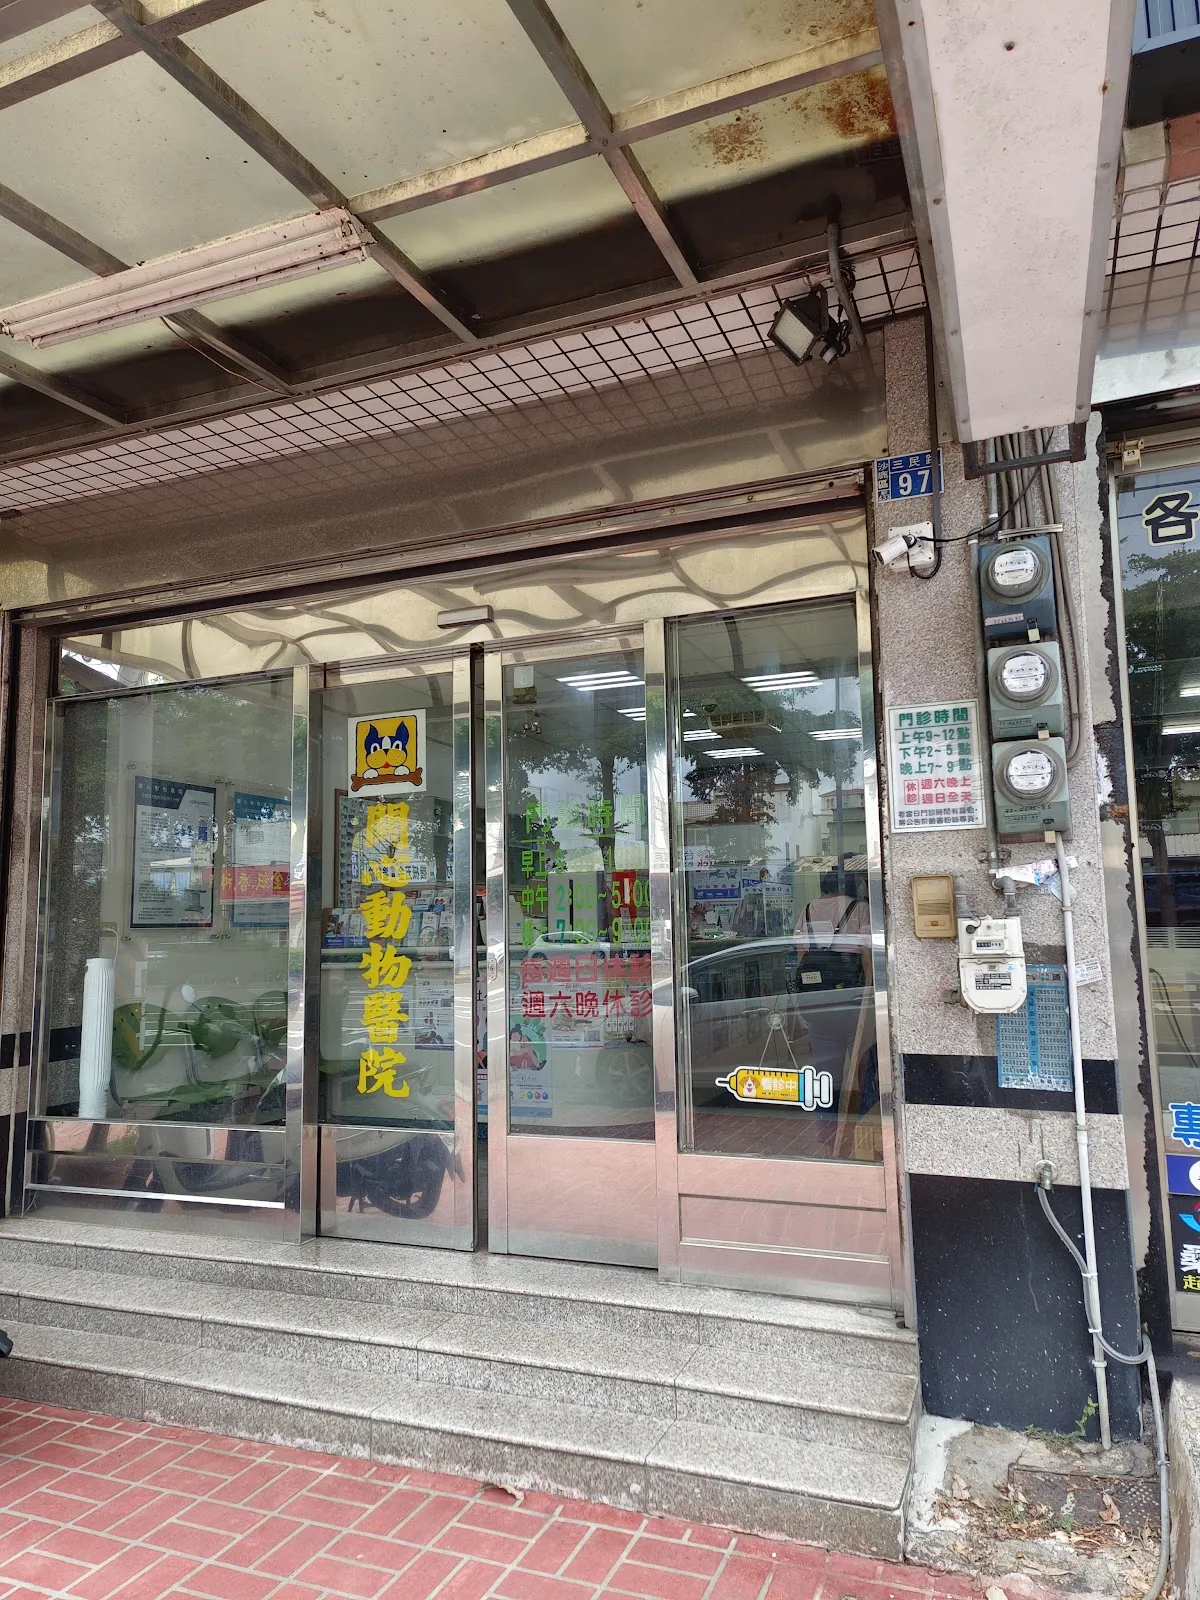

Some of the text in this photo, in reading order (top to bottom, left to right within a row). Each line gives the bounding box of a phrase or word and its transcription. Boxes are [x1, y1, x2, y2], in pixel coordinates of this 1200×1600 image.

[898, 469, 930, 496] 97
[898, 707, 969, 727] 門診時間
[906, 782, 918, 804] 休診
[920, 775, 971, 790] 週六晚上
[921, 790, 972, 805] 週日全天
[520, 953, 652, 990] 每週日休診
[521, 989, 653, 1019] 週六晚休診
[761, 1077, 798, 1092] 看診中
